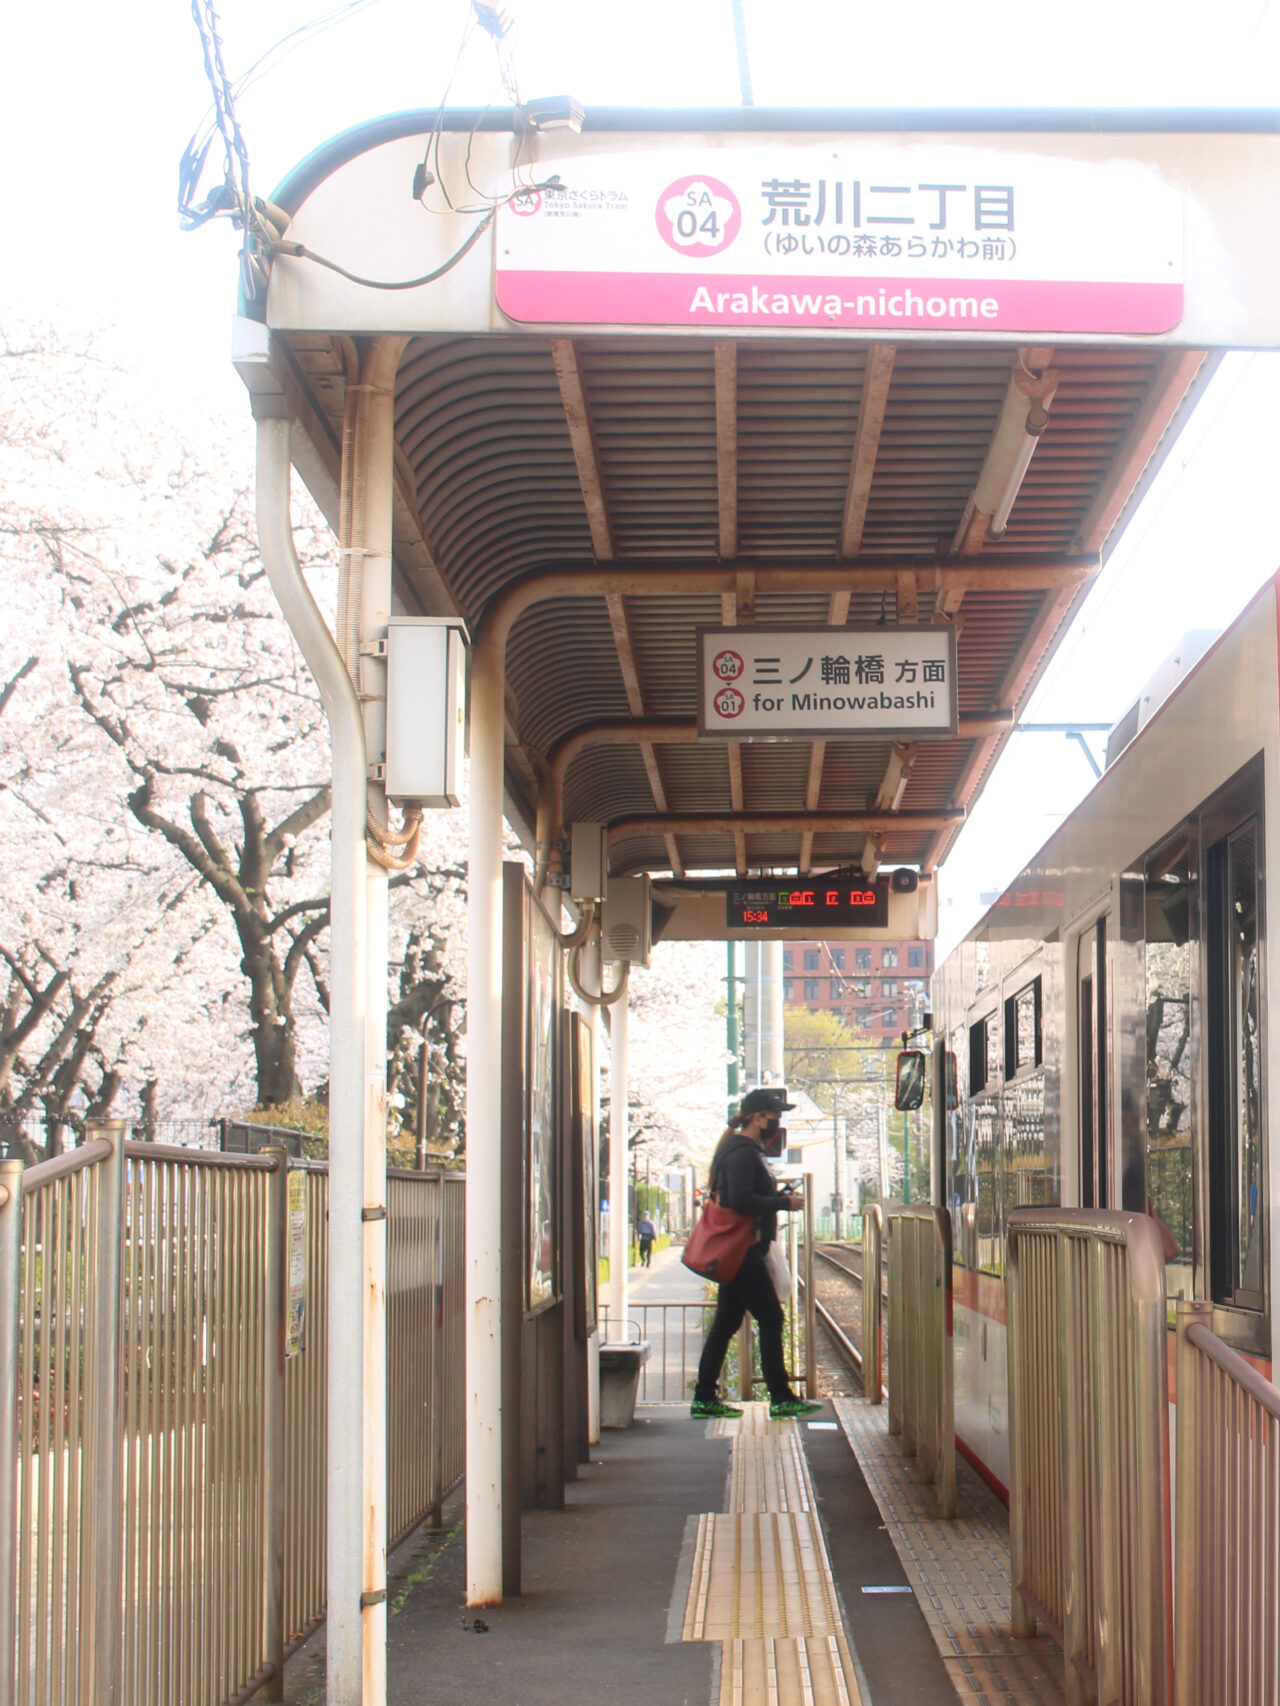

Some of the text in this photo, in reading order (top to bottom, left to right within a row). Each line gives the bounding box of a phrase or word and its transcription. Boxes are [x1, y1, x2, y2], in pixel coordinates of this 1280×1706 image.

[544, 189, 629, 201] 東京さくらトラム
[687, 191, 713, 207] SA
[544, 201, 629, 210] Tokyo Sakura Tram
[761, 178, 1015, 232] 荒川二丁目
[676, 209, 720, 238] 04
[764, 232, 1017, 261] (ゆいの森あらかわ前)
[689, 285, 999, 318] Arakawa-nichome
[720, 663, 736, 674] 04
[753, 654, 946, 686] 三ノ輪橋 方面
[721, 701, 735, 712] 01
[753, 691, 935, 712] for Minowabashi
[743, 910, 768, 923] 15:34
